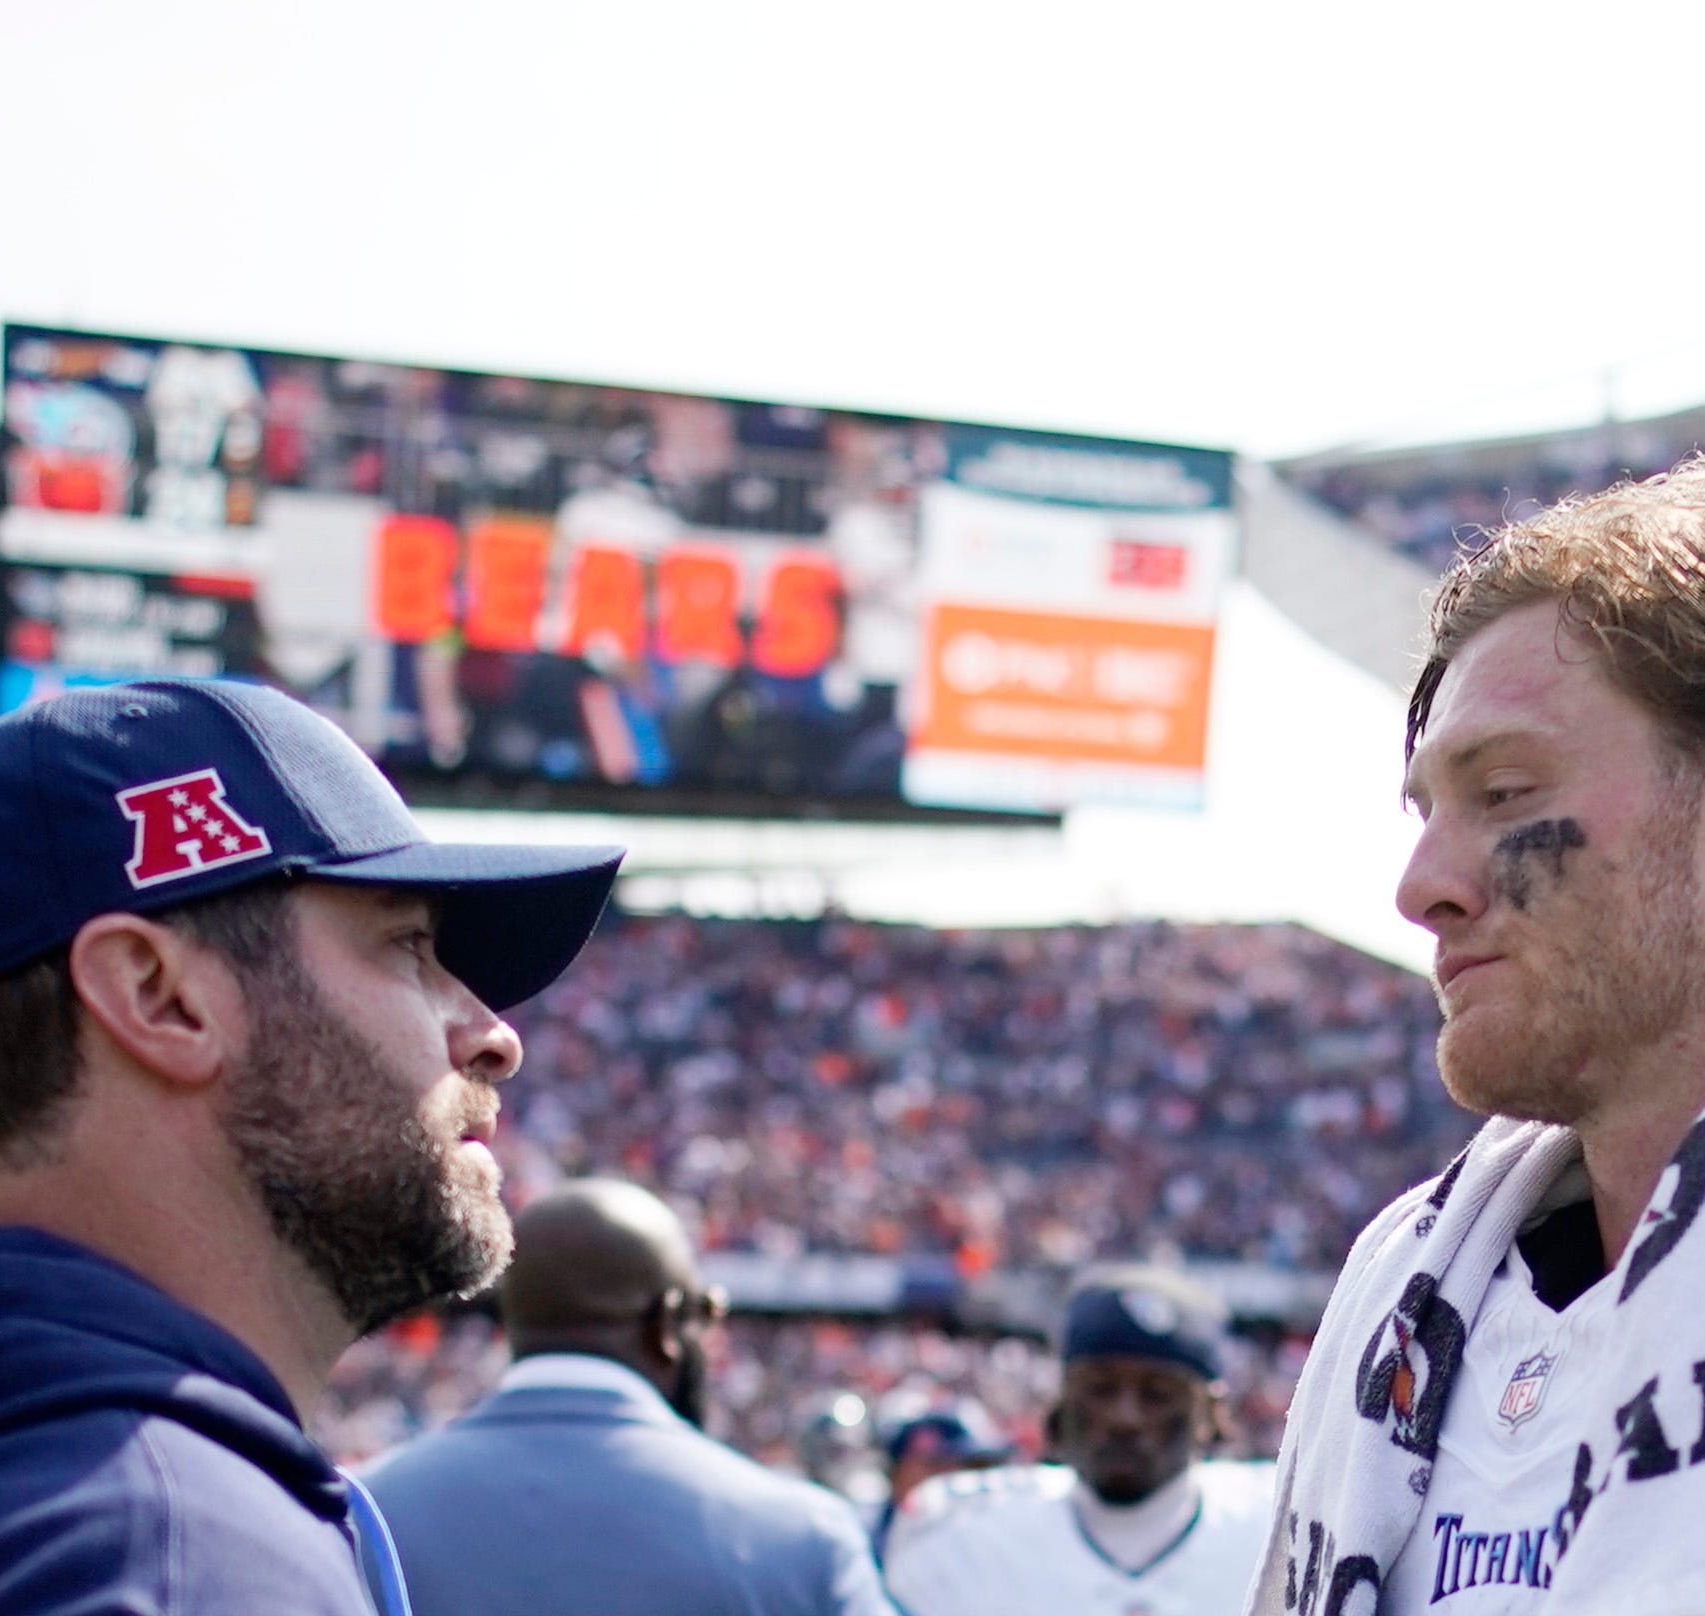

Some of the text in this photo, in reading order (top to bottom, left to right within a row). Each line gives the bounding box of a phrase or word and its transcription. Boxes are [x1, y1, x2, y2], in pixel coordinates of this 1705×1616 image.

[377, 512, 843, 680] BEARS
[115, 767, 273, 890] A
[1501, 1379, 1538, 1415] NFL
